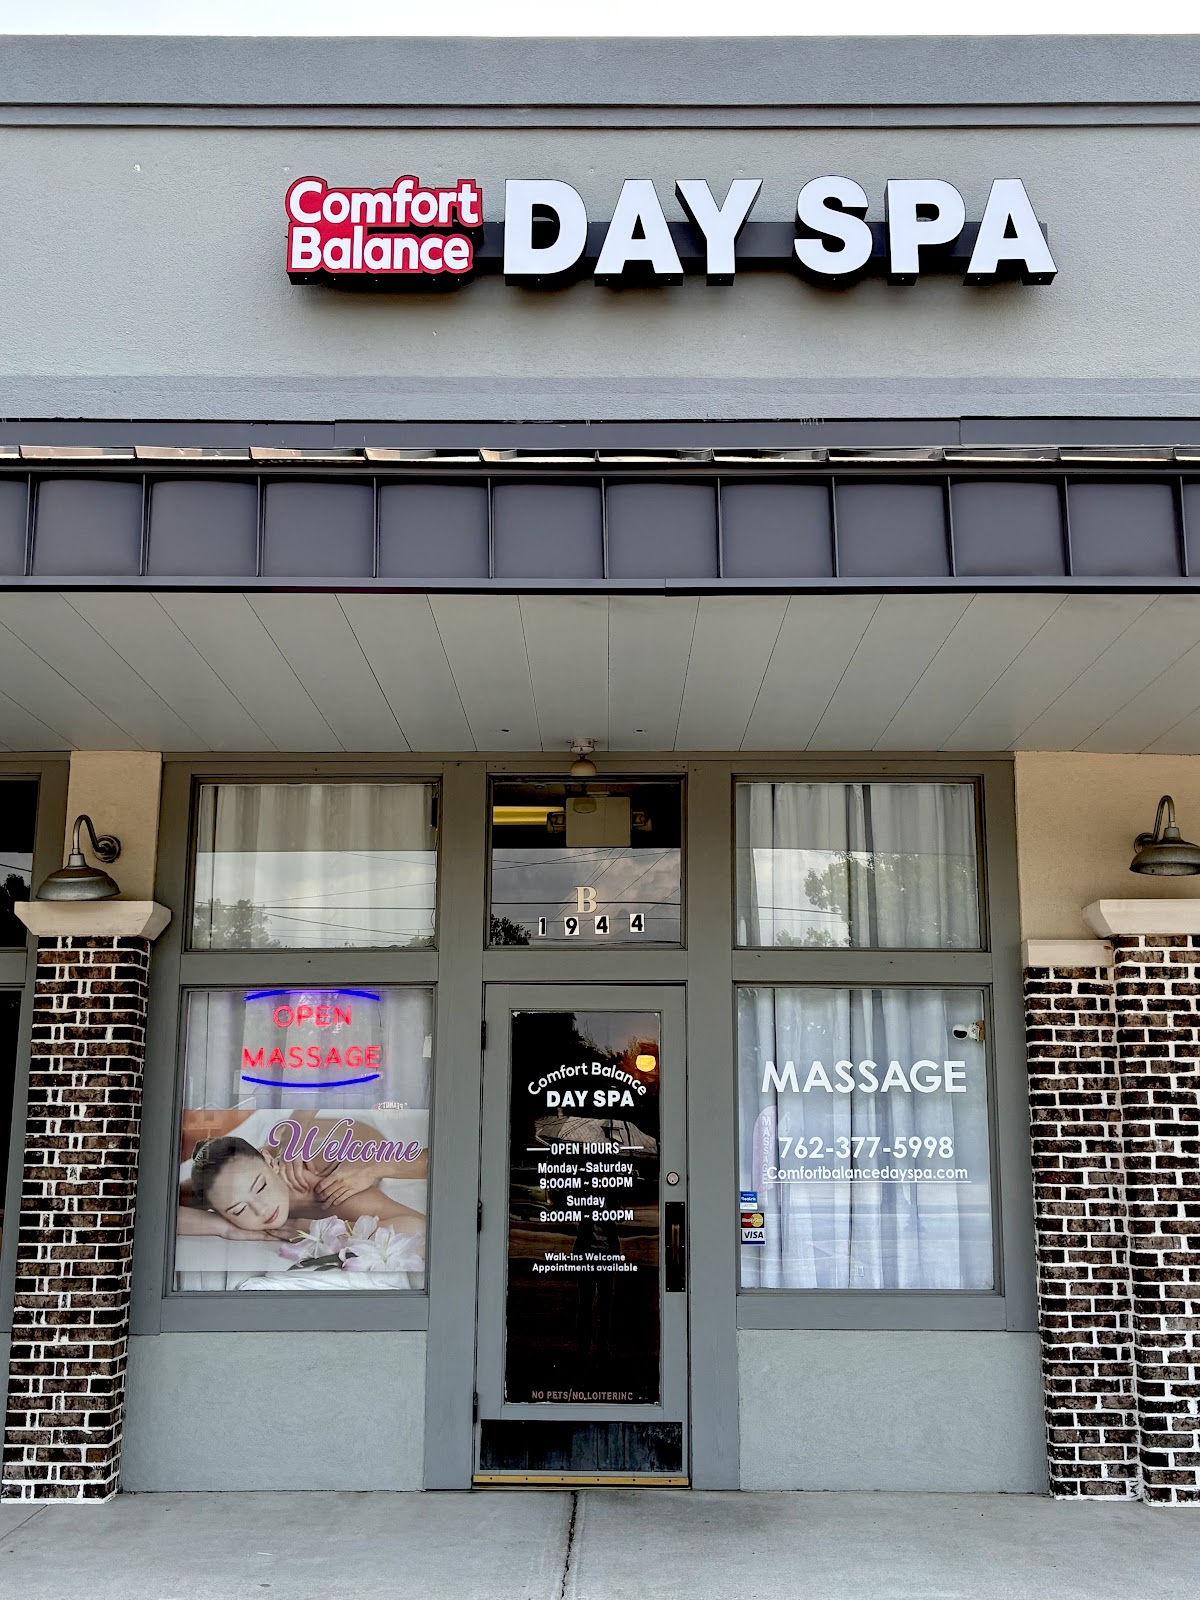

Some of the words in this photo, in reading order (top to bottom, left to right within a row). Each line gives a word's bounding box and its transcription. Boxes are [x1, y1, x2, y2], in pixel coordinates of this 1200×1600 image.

[289, 179, 479, 224] Comfort
[502, 178, 764, 275] DAY
[793, 175, 1058, 276] SPA
[291, 225, 470, 270] Balance
[575, 886, 598, 913] B
[538, 914, 644, 935] 1944
[273, 1005, 352, 1028] OPEN
[241, 1045, 381, 1069] MASSAGE
[527, 1061, 589, 1096] Comfort
[591, 1061, 647, 1096] Balance
[761, 1060, 967, 1094] MASSAGE
[546, 1090, 589, 1108] DAY
[593, 1089, 635, 1108] SPA
[267, 1118, 423, 1162] Welcome
[551, 1143, 580, 1155] OPEN
[582, 1142, 620, 1154] HOURS
[778, 1136, 954, 1159] 762-377-5998
[539, 1178, 582, 1189] 9:00AM
[591, 1177, 633, 1188] 9:00PM
[766, 1165, 968, 1183] Comfortbalancedayspa.com
[566, 1195, 606, 1208] Sunday
[539, 1211, 582, 1222] 9:00AM
[592, 1210, 634, 1221] 8:00PM
[744, 1231, 764, 1239] VISA
[544, 1252, 583, 1261] Walk-ins
[584, 1252, 626, 1261] Welcome
[532, 1263, 595, 1273] Appointments
[596, 1263, 638, 1272] available
[531, 1390, 544, 1400] NO
